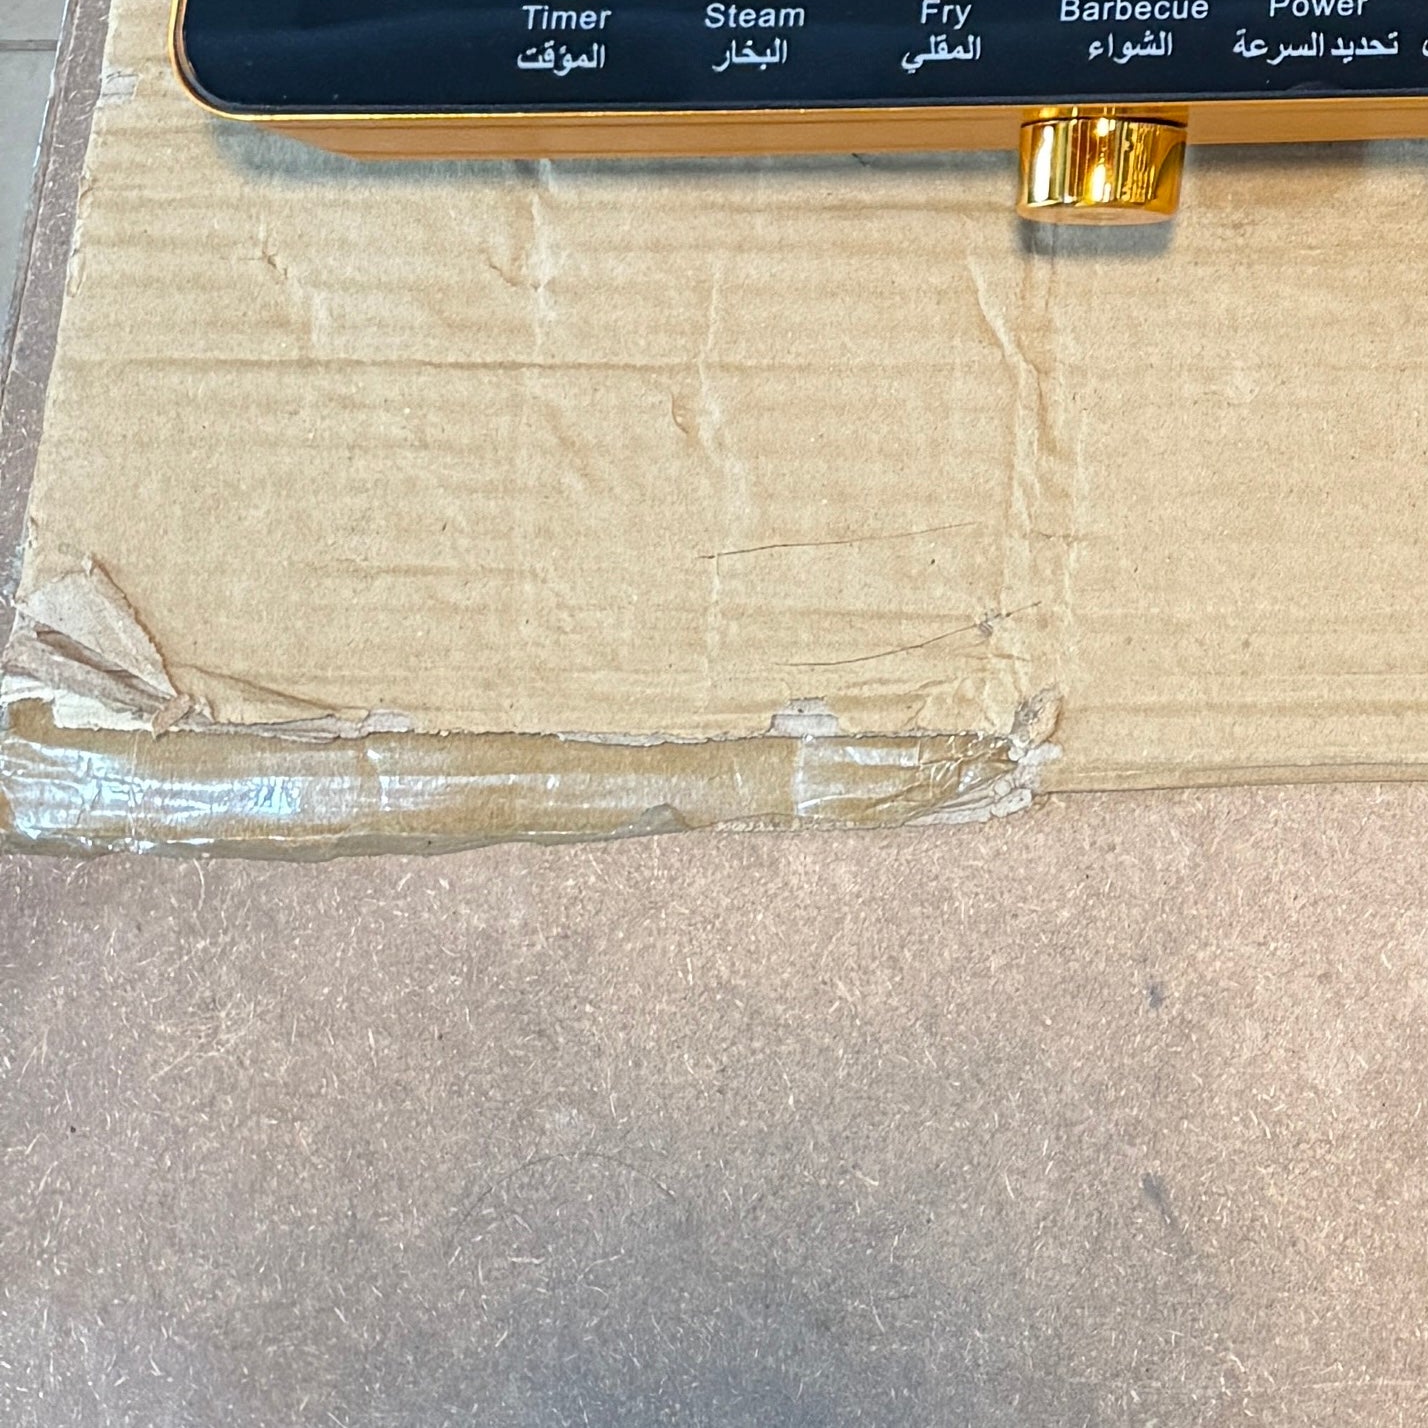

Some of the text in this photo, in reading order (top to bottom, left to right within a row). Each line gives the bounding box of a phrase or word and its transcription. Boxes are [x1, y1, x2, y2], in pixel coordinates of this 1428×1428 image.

[521, 5, 612, 30] Timer
[704, 2, 805, 29] Steam
[517, 40, 606, 77] المؤقت
[711, 37, 788, 72] البخار
[901, 33, 981, 74] المقلي
[1088, 30, 1173, 64] الشواء
[1232, 28, 1399, 66] تحديد السرعة
